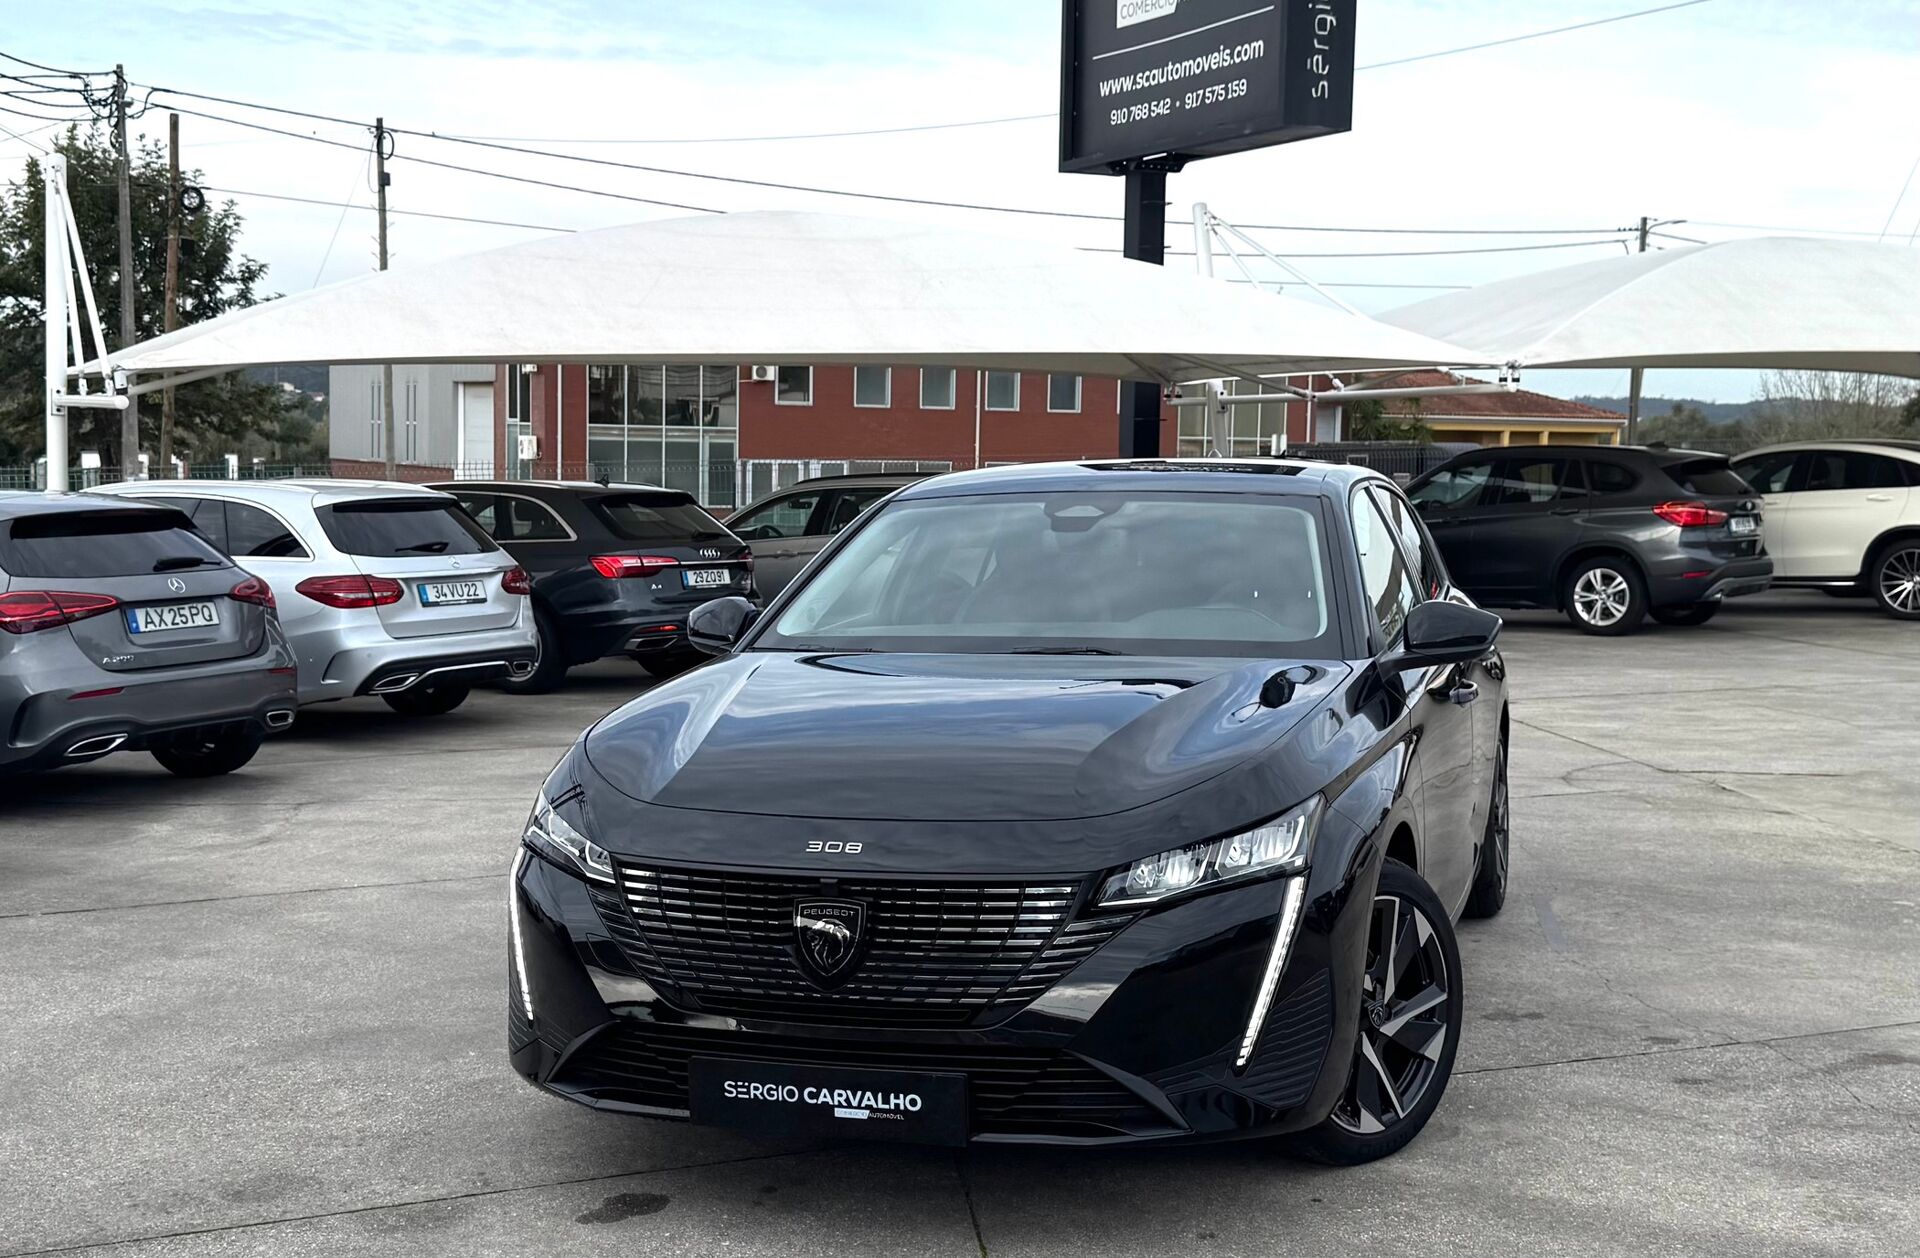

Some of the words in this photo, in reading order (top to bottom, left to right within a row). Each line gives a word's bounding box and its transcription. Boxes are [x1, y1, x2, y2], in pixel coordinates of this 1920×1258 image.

[1099, 39, 1264, 97] www.scautomoveis.com
[1110, 108, 1128, 125] 910
[1129, 103, 1149, 122] 768
[1150, 98, 1171, 117] 542
[1184, 89, 1204, 109] 917
[1204, 84, 1225, 104] 575
[1227, 78, 1247, 99] 159
[433, 583, 479, 599] 34VU22
[144, 604, 213, 629] AX25PQ
[806, 841, 863, 854] 308
[803, 908, 856, 917] PEUGEOT
[803, 1086, 922, 1112] CARVALHO
